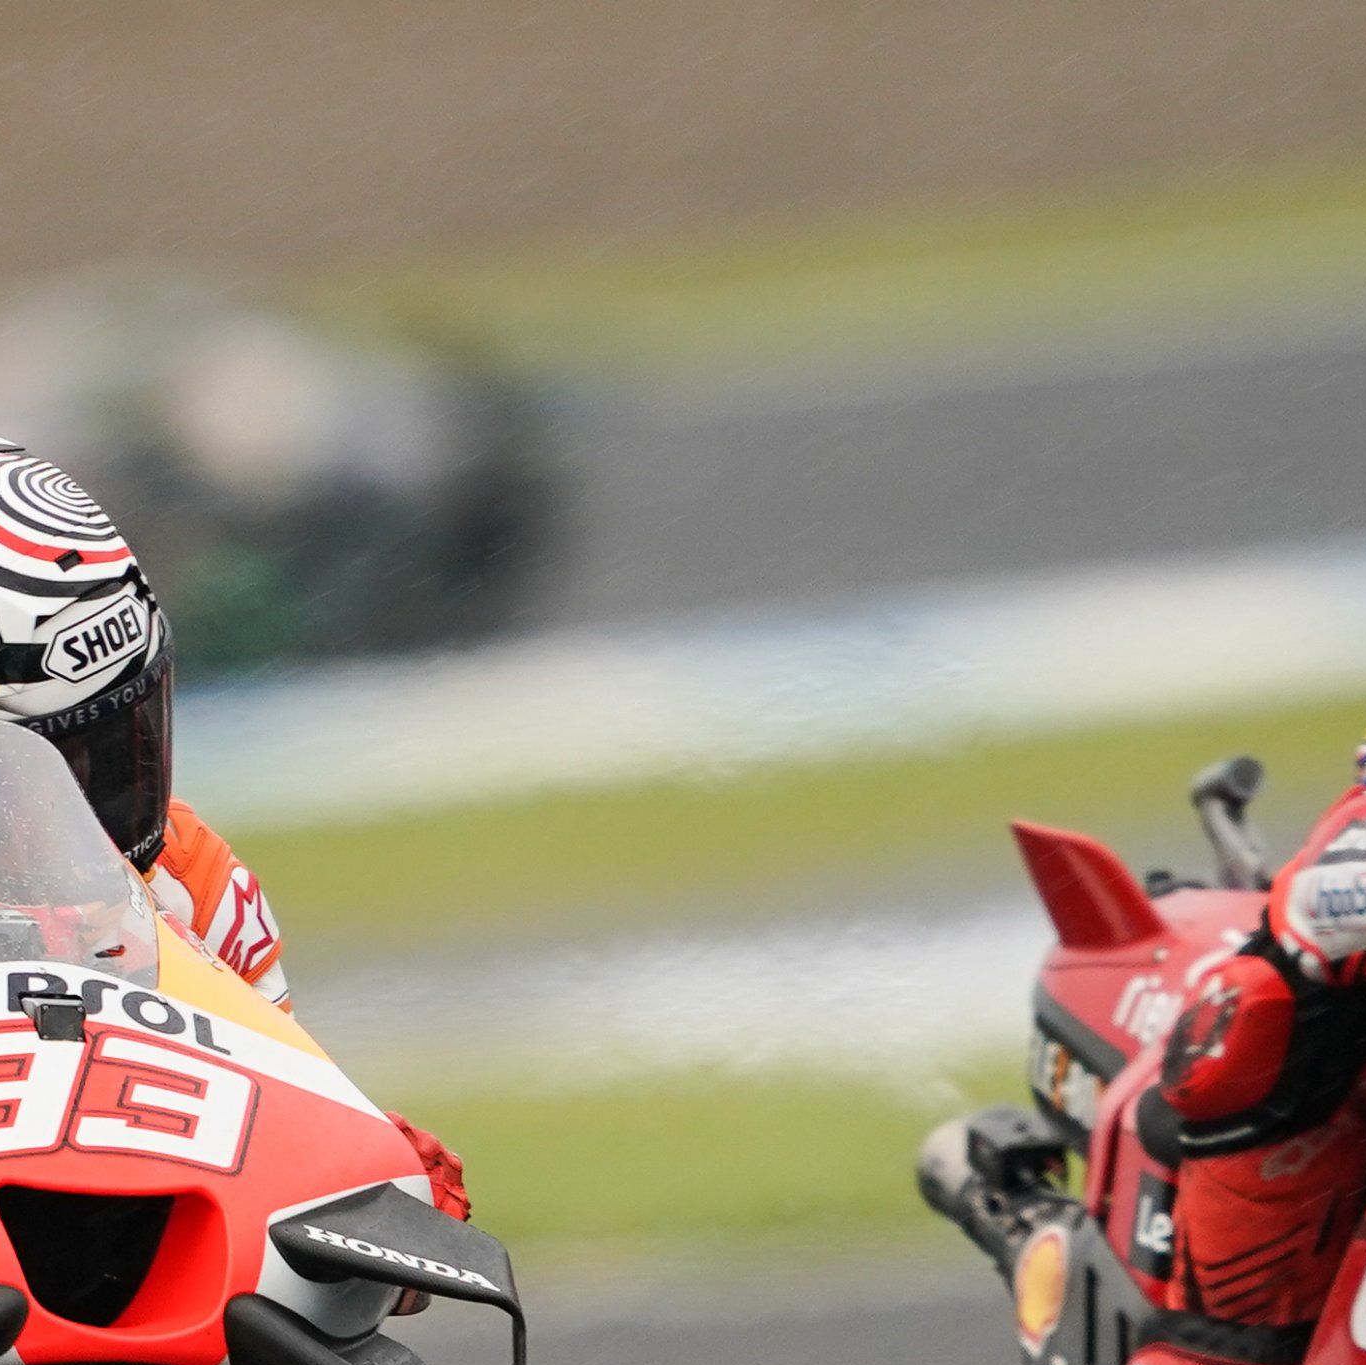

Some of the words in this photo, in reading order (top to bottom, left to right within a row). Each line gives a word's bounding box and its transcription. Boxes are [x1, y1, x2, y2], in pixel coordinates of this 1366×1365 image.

[62, 604, 143, 672] SHOEI
[28, 704, 99, 734] GIVES
[111, 681, 147, 709] YOU
[304, 1224, 501, 1293] HONDA
